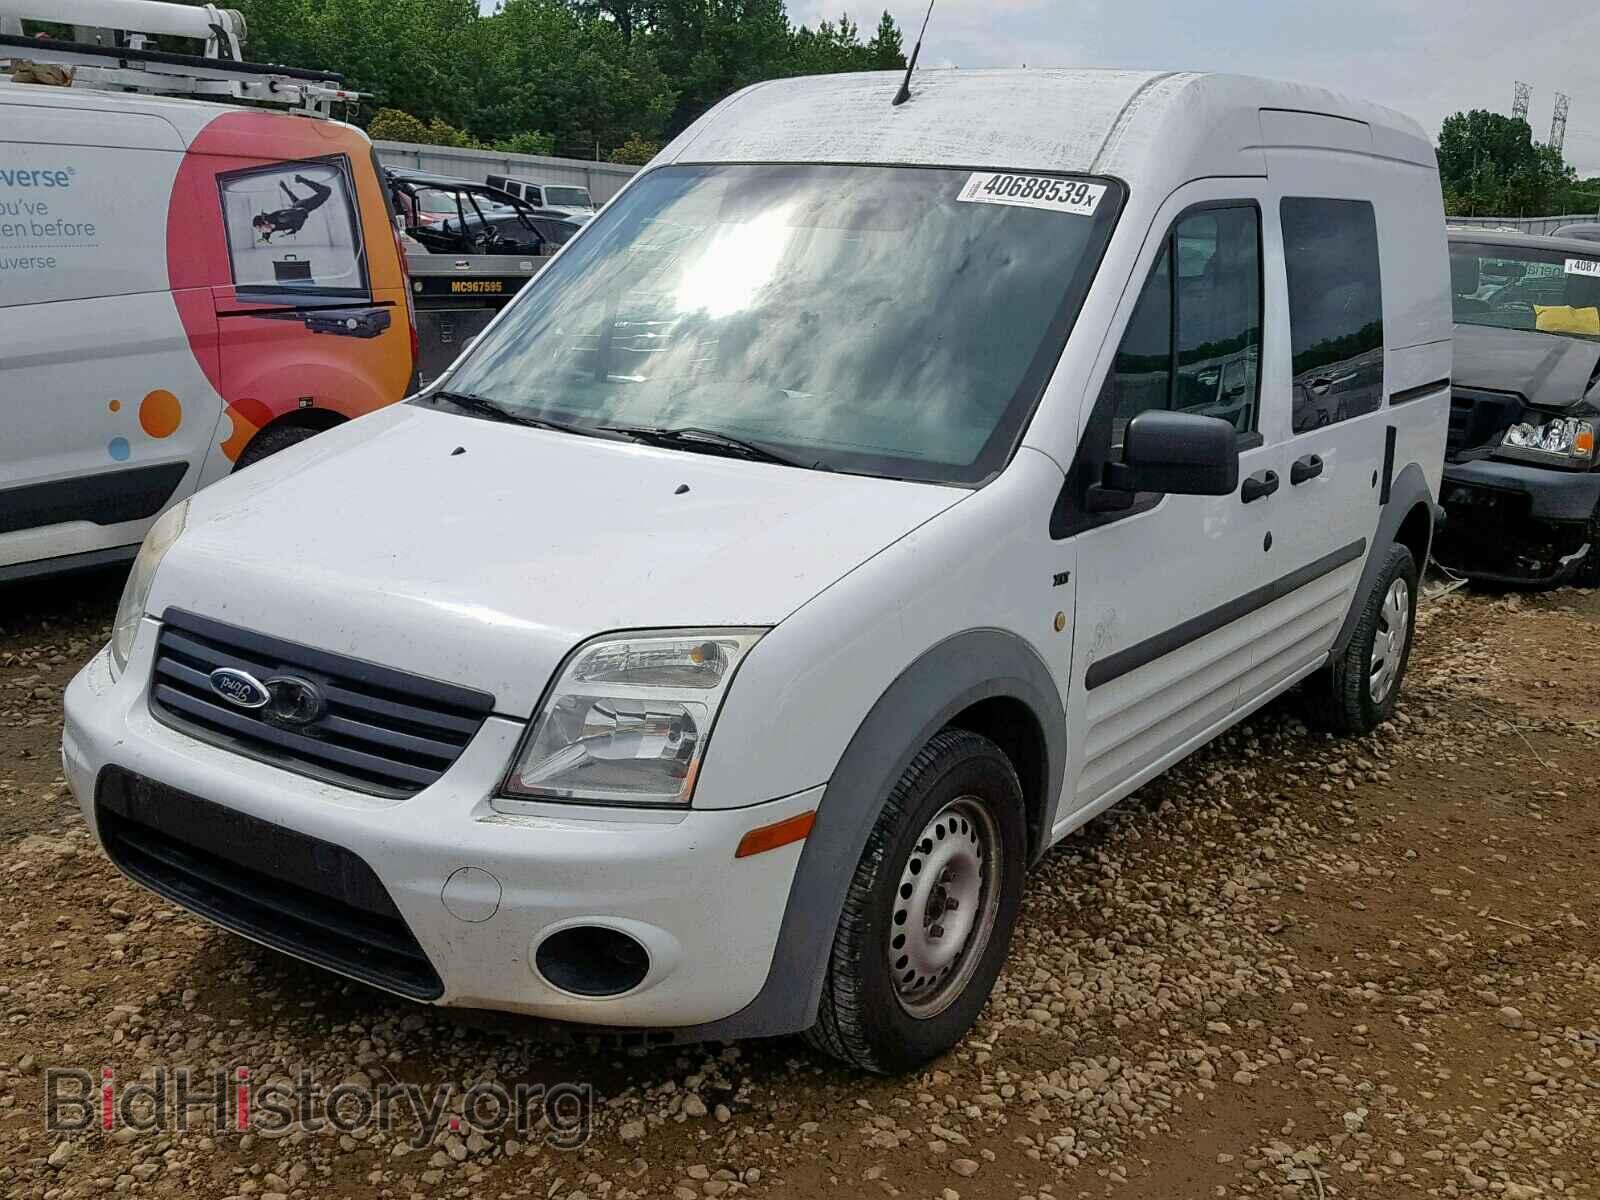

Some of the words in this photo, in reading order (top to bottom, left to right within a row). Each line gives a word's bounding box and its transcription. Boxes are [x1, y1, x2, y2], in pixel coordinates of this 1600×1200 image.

[30, 218, 97, 237] before
[1574, 260, 1600, 273] 4087
[451, 281, 503, 293] MC967595
